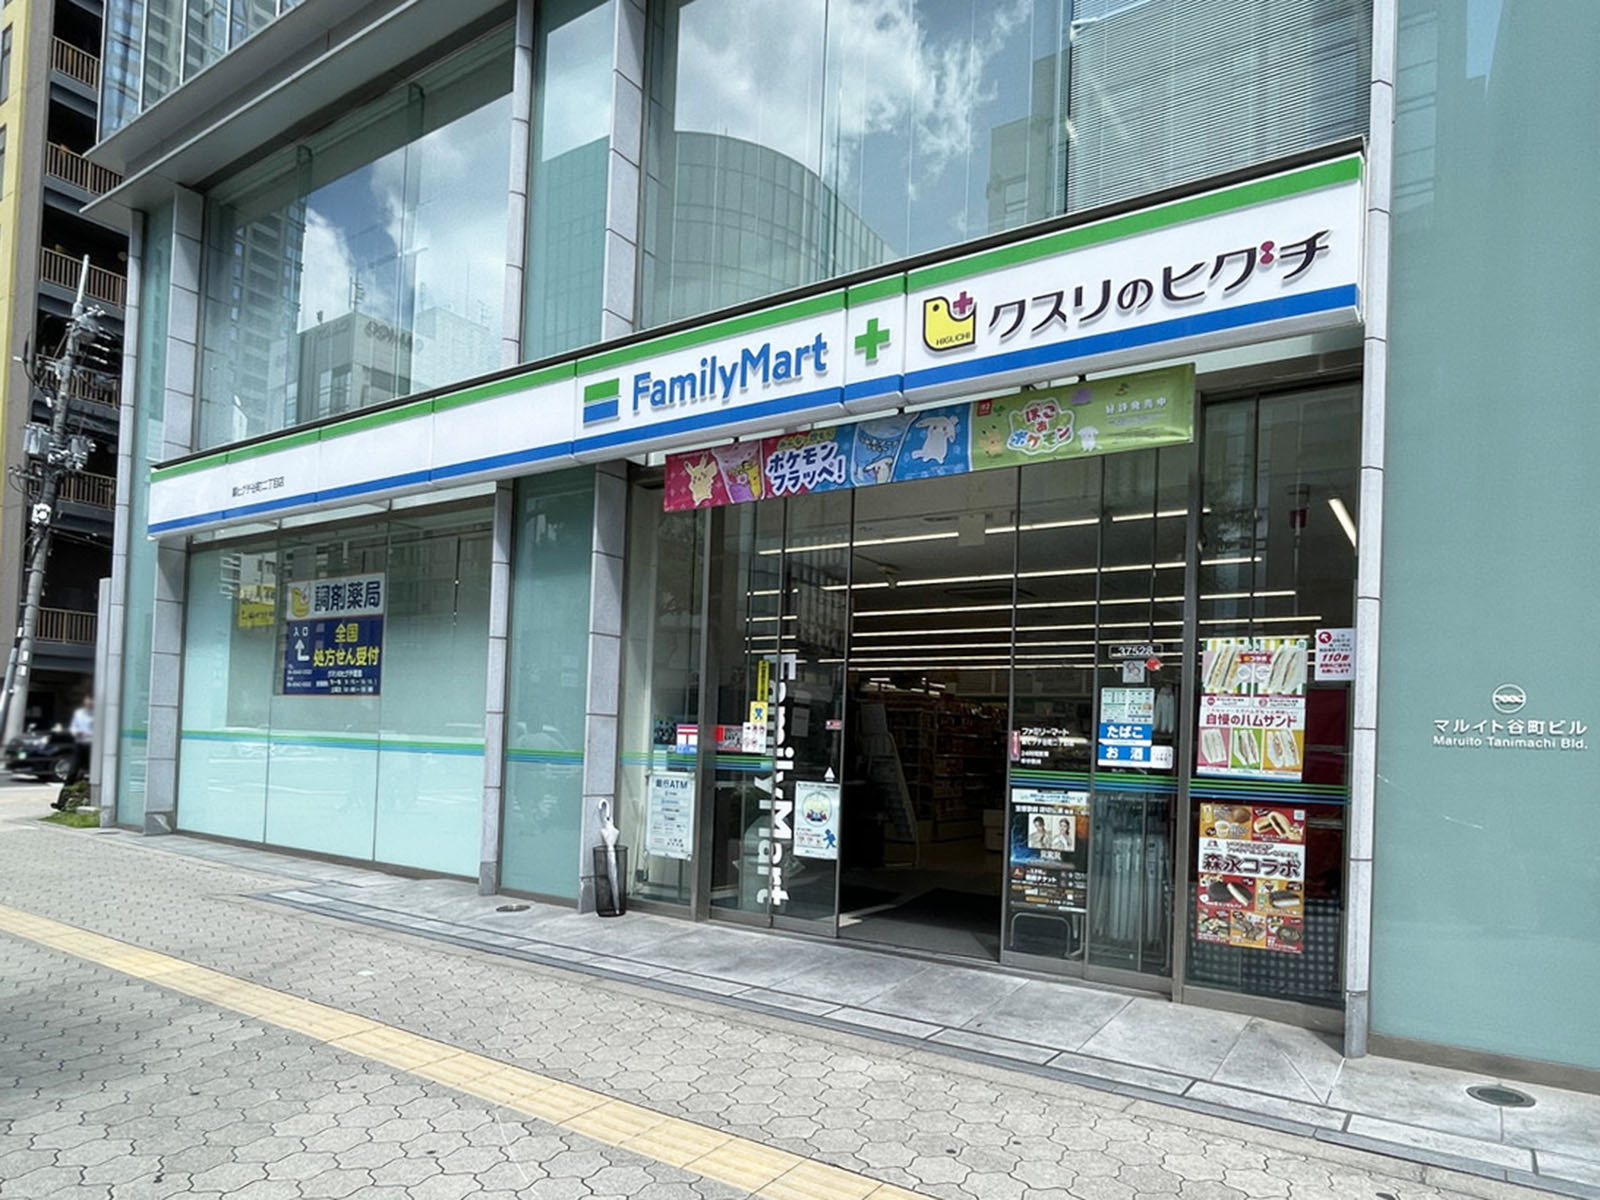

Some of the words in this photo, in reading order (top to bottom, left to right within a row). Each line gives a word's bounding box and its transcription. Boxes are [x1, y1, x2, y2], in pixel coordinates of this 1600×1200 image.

[989, 229, 1330, 338] クスリのヒグチ
[935, 331, 971, 346] HIGUCHI
[633, 332, 827, 411] FamilyMart
[768, 443, 837, 473] ポケモン
[314, 580, 381, 613] 調剤薬局
[293, 626, 309, 637] 入口
[335, 623, 359, 643] 全国
[313, 646, 380, 667] 処方せん受付
[1118, 645, 1153, 656] 37528
[1206, 713, 1297, 728] 自慢のハムサンド
[1433, 719, 1588, 735] マルイト谷町ビル
[1107, 725, 1143, 739] たばこ
[1433, 735, 1482, 747] Maruito
[1487, 736, 1556, 749] Tanimachi
[1560, 738, 1588, 750] Bld.
[1203, 853, 1301, 878] 森永コラボ
